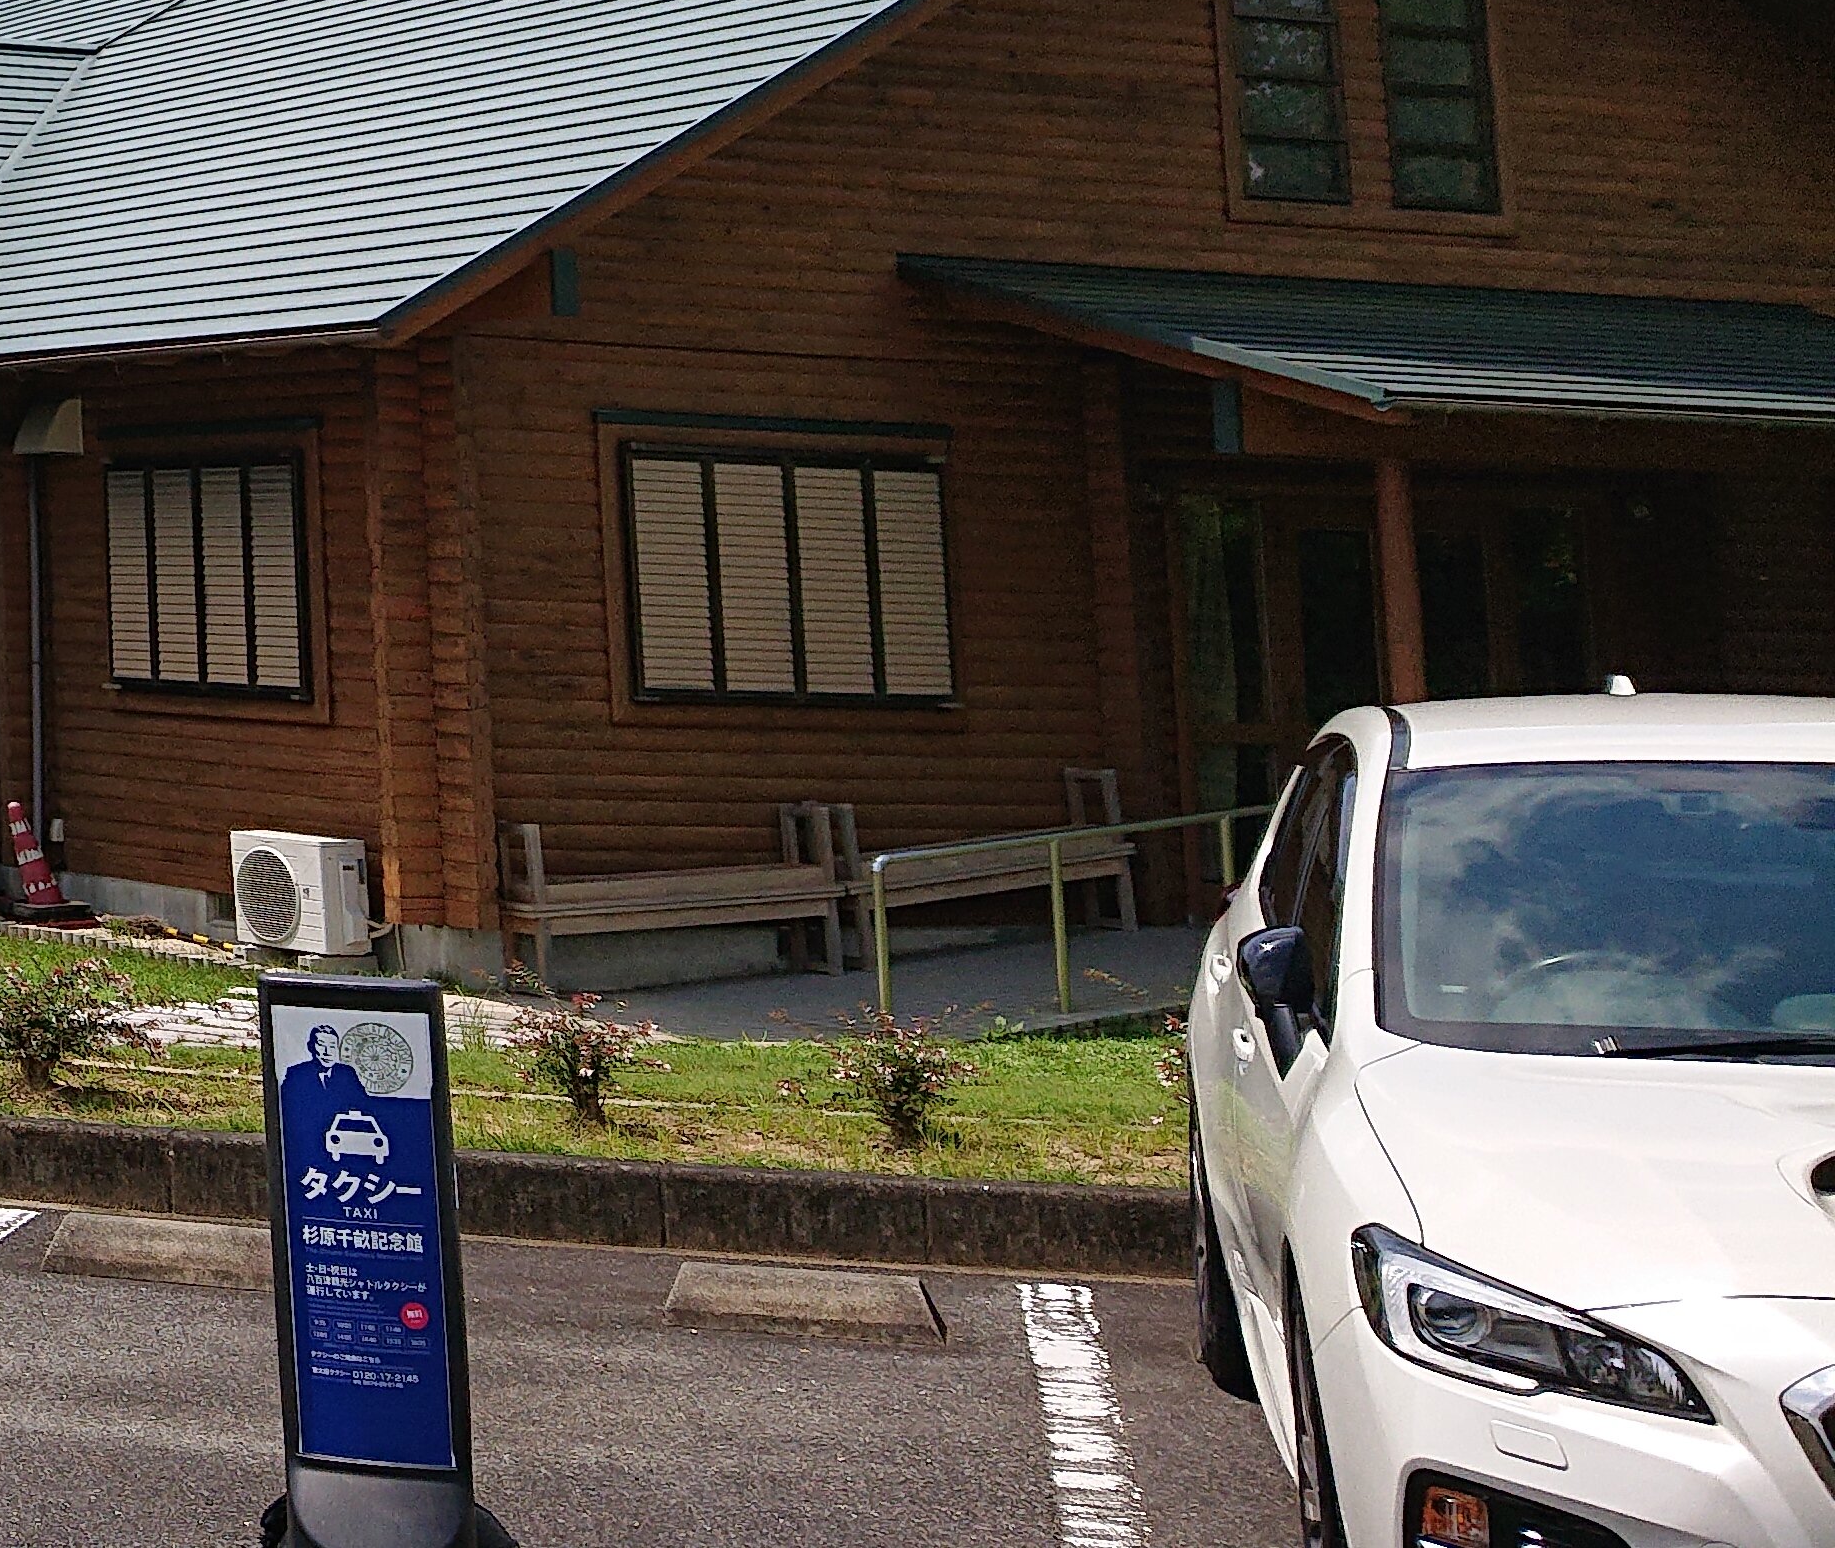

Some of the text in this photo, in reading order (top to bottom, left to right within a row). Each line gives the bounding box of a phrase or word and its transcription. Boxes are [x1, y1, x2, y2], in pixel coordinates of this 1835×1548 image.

[299, 1166, 423, 1204] タクシー
[343, 1206, 378, 1220] TAXI
[302, 1224, 424, 1254] 杉原千畝記念館
